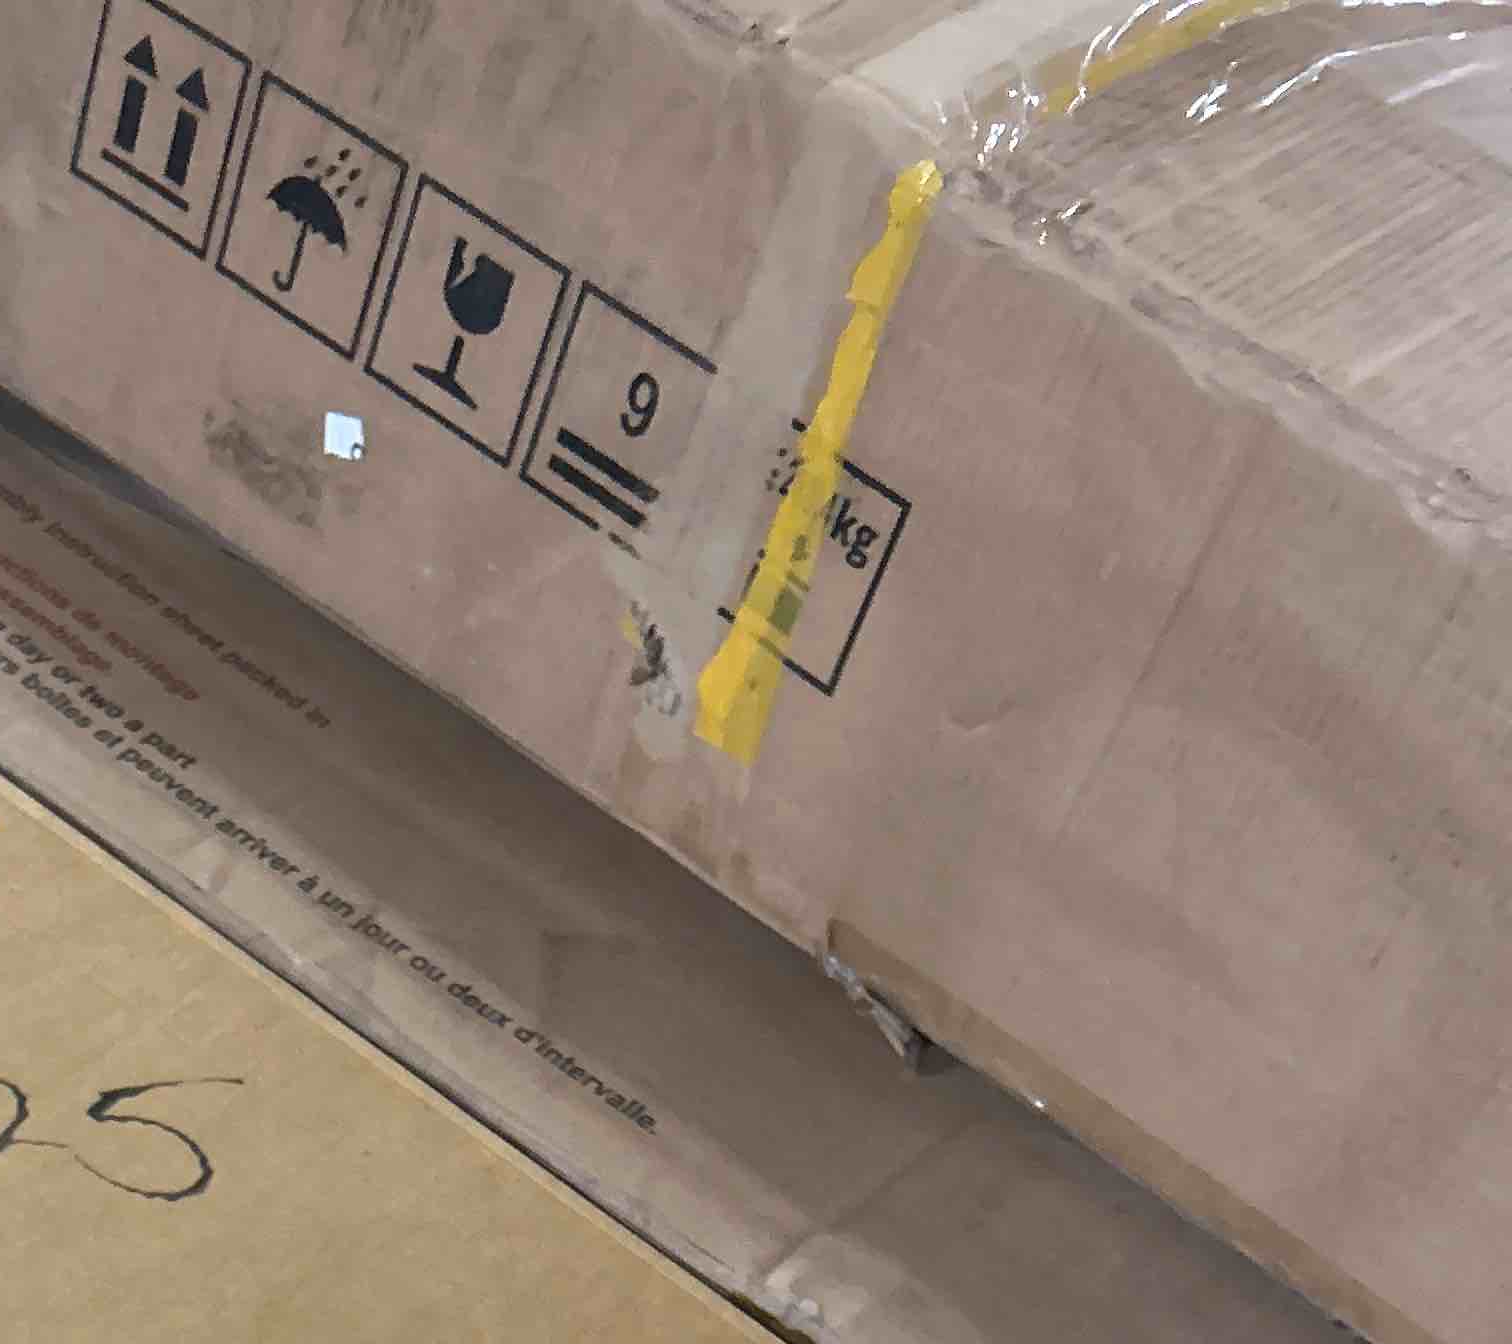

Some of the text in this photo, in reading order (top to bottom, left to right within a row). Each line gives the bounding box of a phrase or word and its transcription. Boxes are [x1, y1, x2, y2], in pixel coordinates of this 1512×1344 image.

[618, 370, 662, 438] 9
[7, 628, 55, 667] day
[50, 660, 83, 685] or
[85, 672, 126, 720] two
[139, 722, 198, 770] part
[93, 722, 123, 750] et
[115, 744, 219, 820] peuvent
[214, 815, 300, 876] arriver
[296, 869, 320, 899] à
[316, 889, 354, 921] un
[348, 911, 409, 962] jour
[408, 952, 446, 986] ou
[445, 976, 514, 1030] deux
[512, 1025, 659, 1137] d'intervalle.
